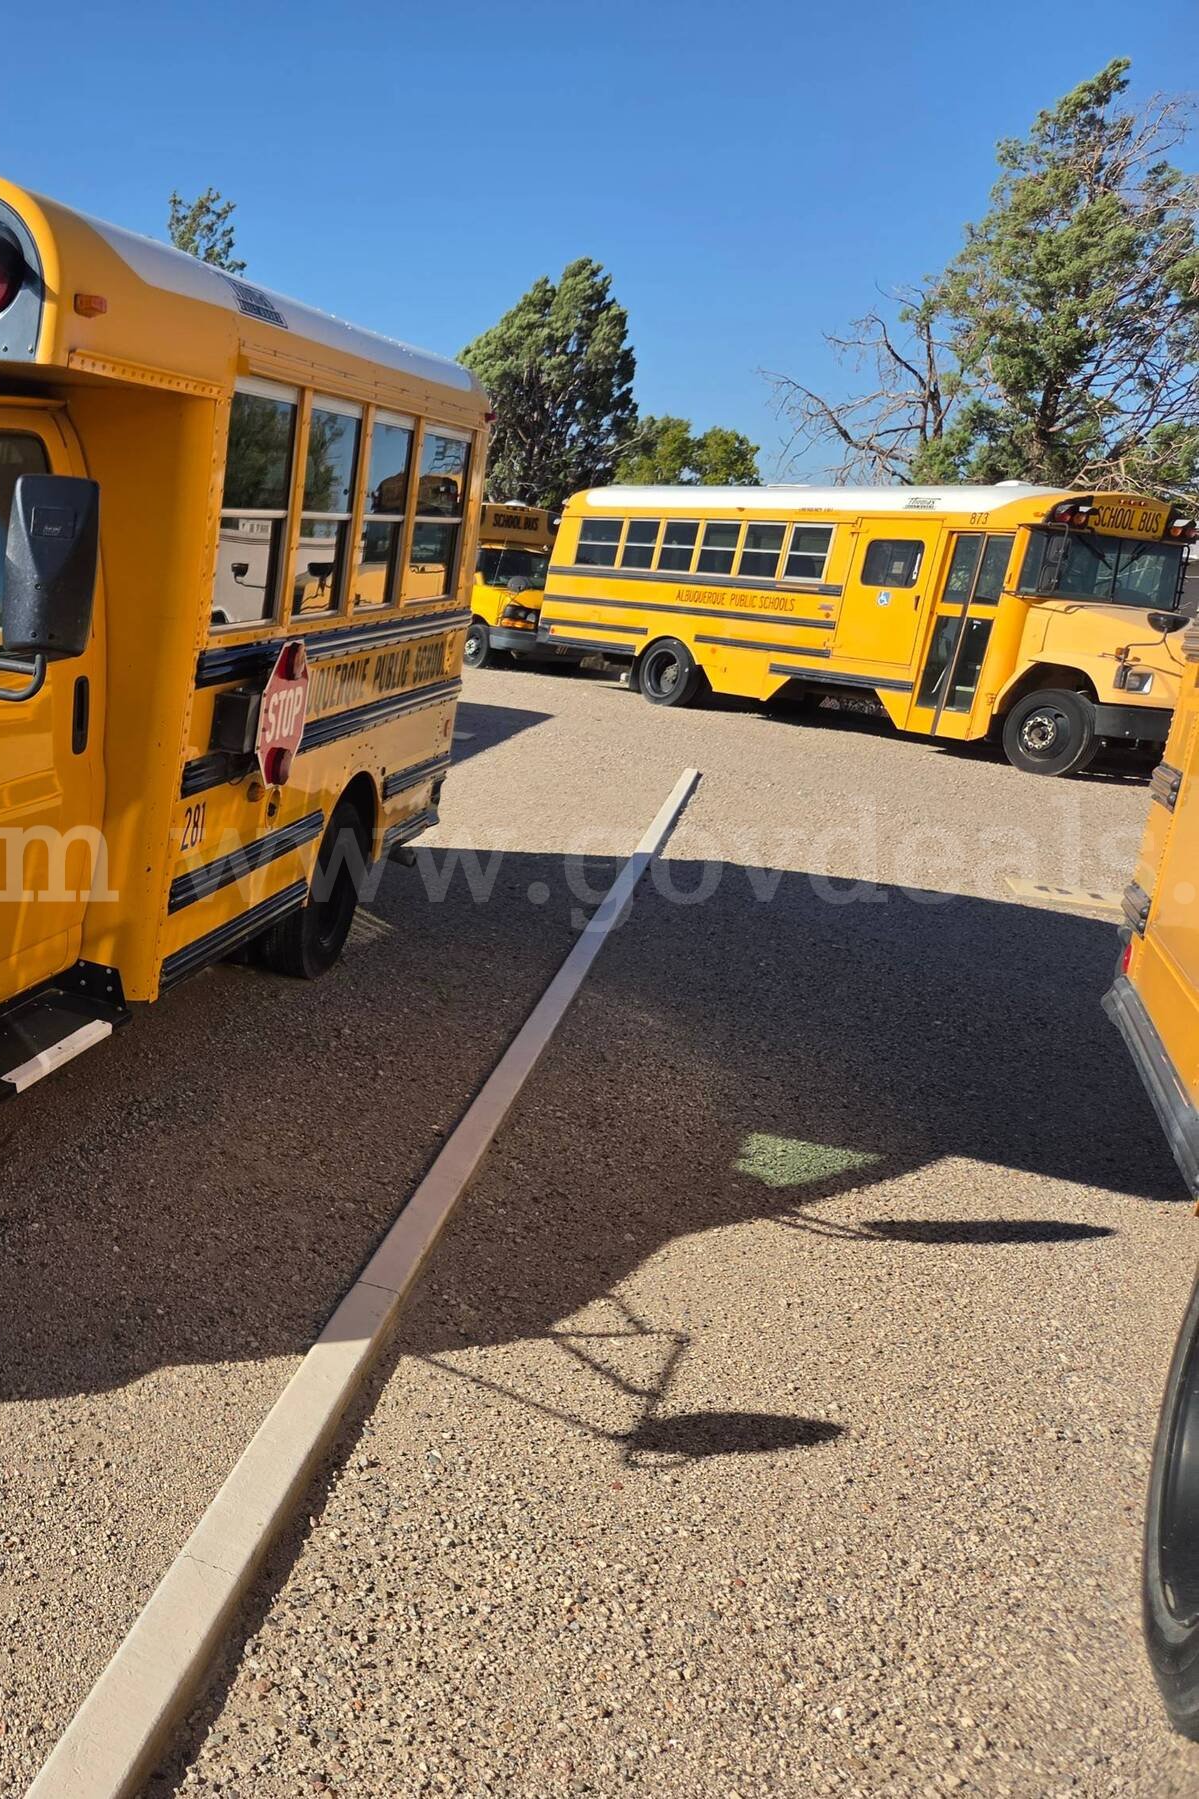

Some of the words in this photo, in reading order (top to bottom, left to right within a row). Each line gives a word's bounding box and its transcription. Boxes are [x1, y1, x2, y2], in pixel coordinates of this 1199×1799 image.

[492, 513, 521, 529] SCHOOL
[524, 516, 540, 531] BUS
[969, 512, 990, 525] 873
[1094, 505, 1136, 531] SCHOOL
[1138, 511, 1162, 534] BUS
[675, 589, 728, 606] ALBUQUERQUE
[729, 593, 757, 608] PUBLIC
[758, 595, 796, 612] SCHOOLS
[373, 649, 410, 694] PUBLIC
[265, 686, 304, 744] STOP
[180, 801, 207, 852] 281
